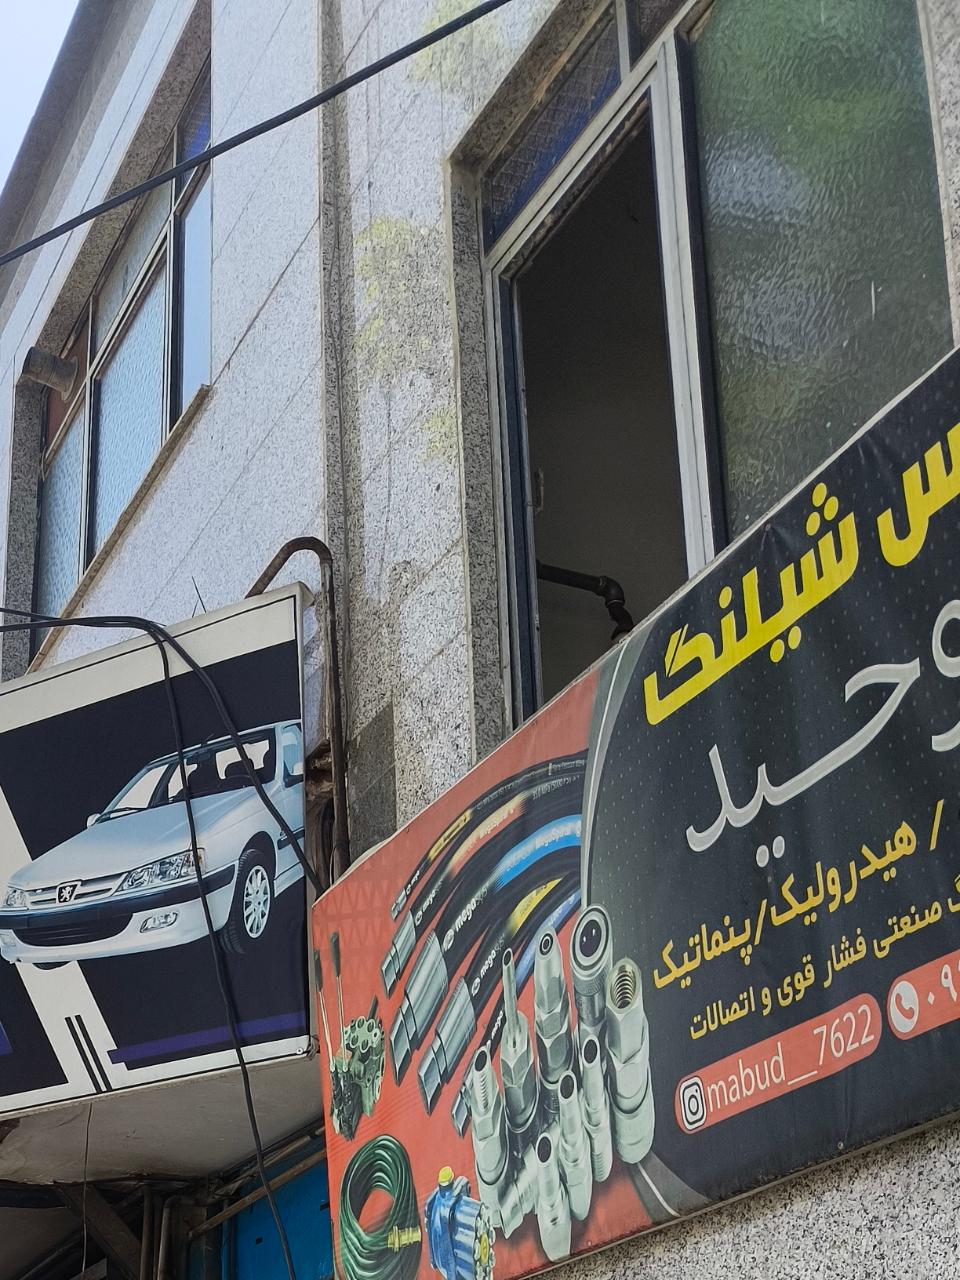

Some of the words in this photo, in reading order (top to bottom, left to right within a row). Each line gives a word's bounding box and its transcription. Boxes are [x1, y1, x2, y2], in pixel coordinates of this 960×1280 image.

[643, 483, 859, 726] شیلنگ
[823, 927, 867, 988] فشار
[872, 899, 942, 960] صنعتی
[761, 986, 770, 1017] و
[777, 953, 816, 1008] قوی
[690, 984, 756, 1040] اتصالات
